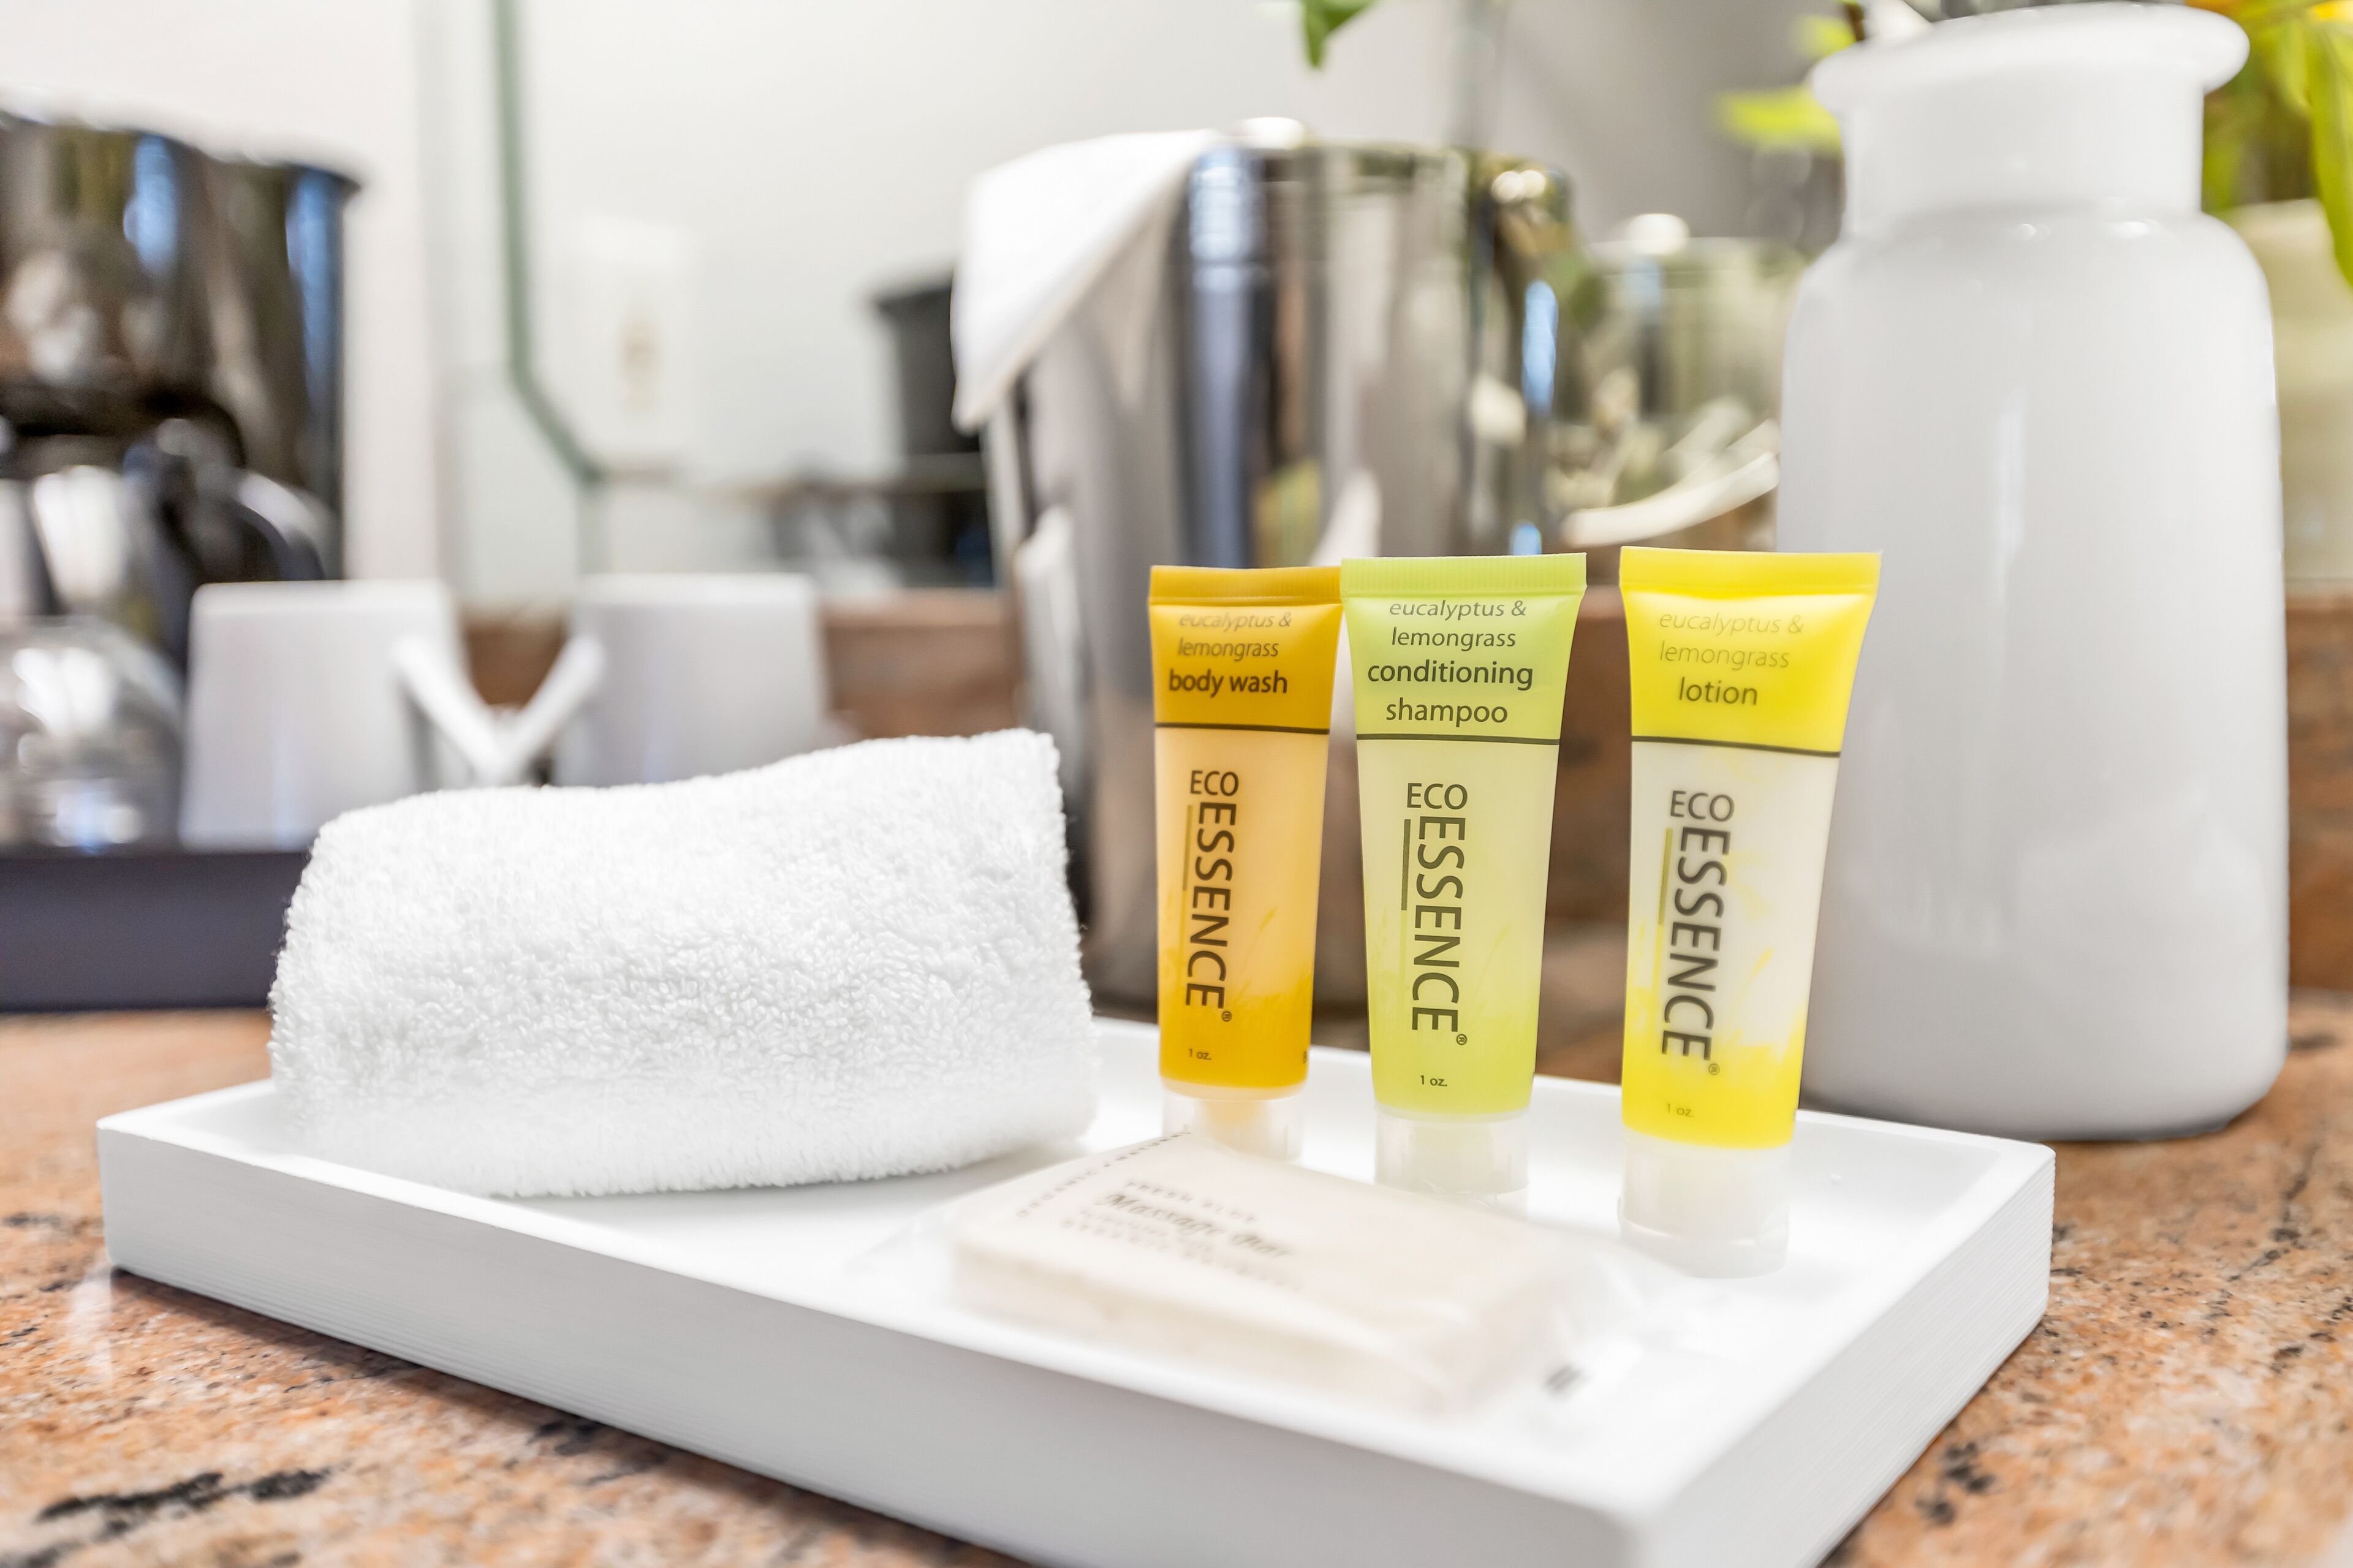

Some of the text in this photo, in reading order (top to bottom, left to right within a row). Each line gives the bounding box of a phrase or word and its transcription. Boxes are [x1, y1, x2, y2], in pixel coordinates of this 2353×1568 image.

[1179, 612, 1292, 632] eucalyptus &
[1389, 600, 1526, 621] eucalyptus &
[1659, 612, 1805, 637] eucalyptus &
[1178, 637, 1279, 662] lemongrass
[1392, 626, 1517, 652] lemongrass
[1659, 640, 1790, 671] lemongrass
[1169, 668, 1287, 698] body wash
[1368, 659, 1533, 691] conditioning
[1678, 676, 1758, 705] lotion
[1385, 697, 1508, 728] shampoo
[1189, 770, 1240, 797] ECO
[1406, 782, 1468, 811] ECO
[1670, 790, 1735, 823] ECO
[1188, 1048, 1193, 1058] 1
[1420, 1075, 1447, 1087] 1 oz.
[1666, 1103, 1671, 1113] 1
